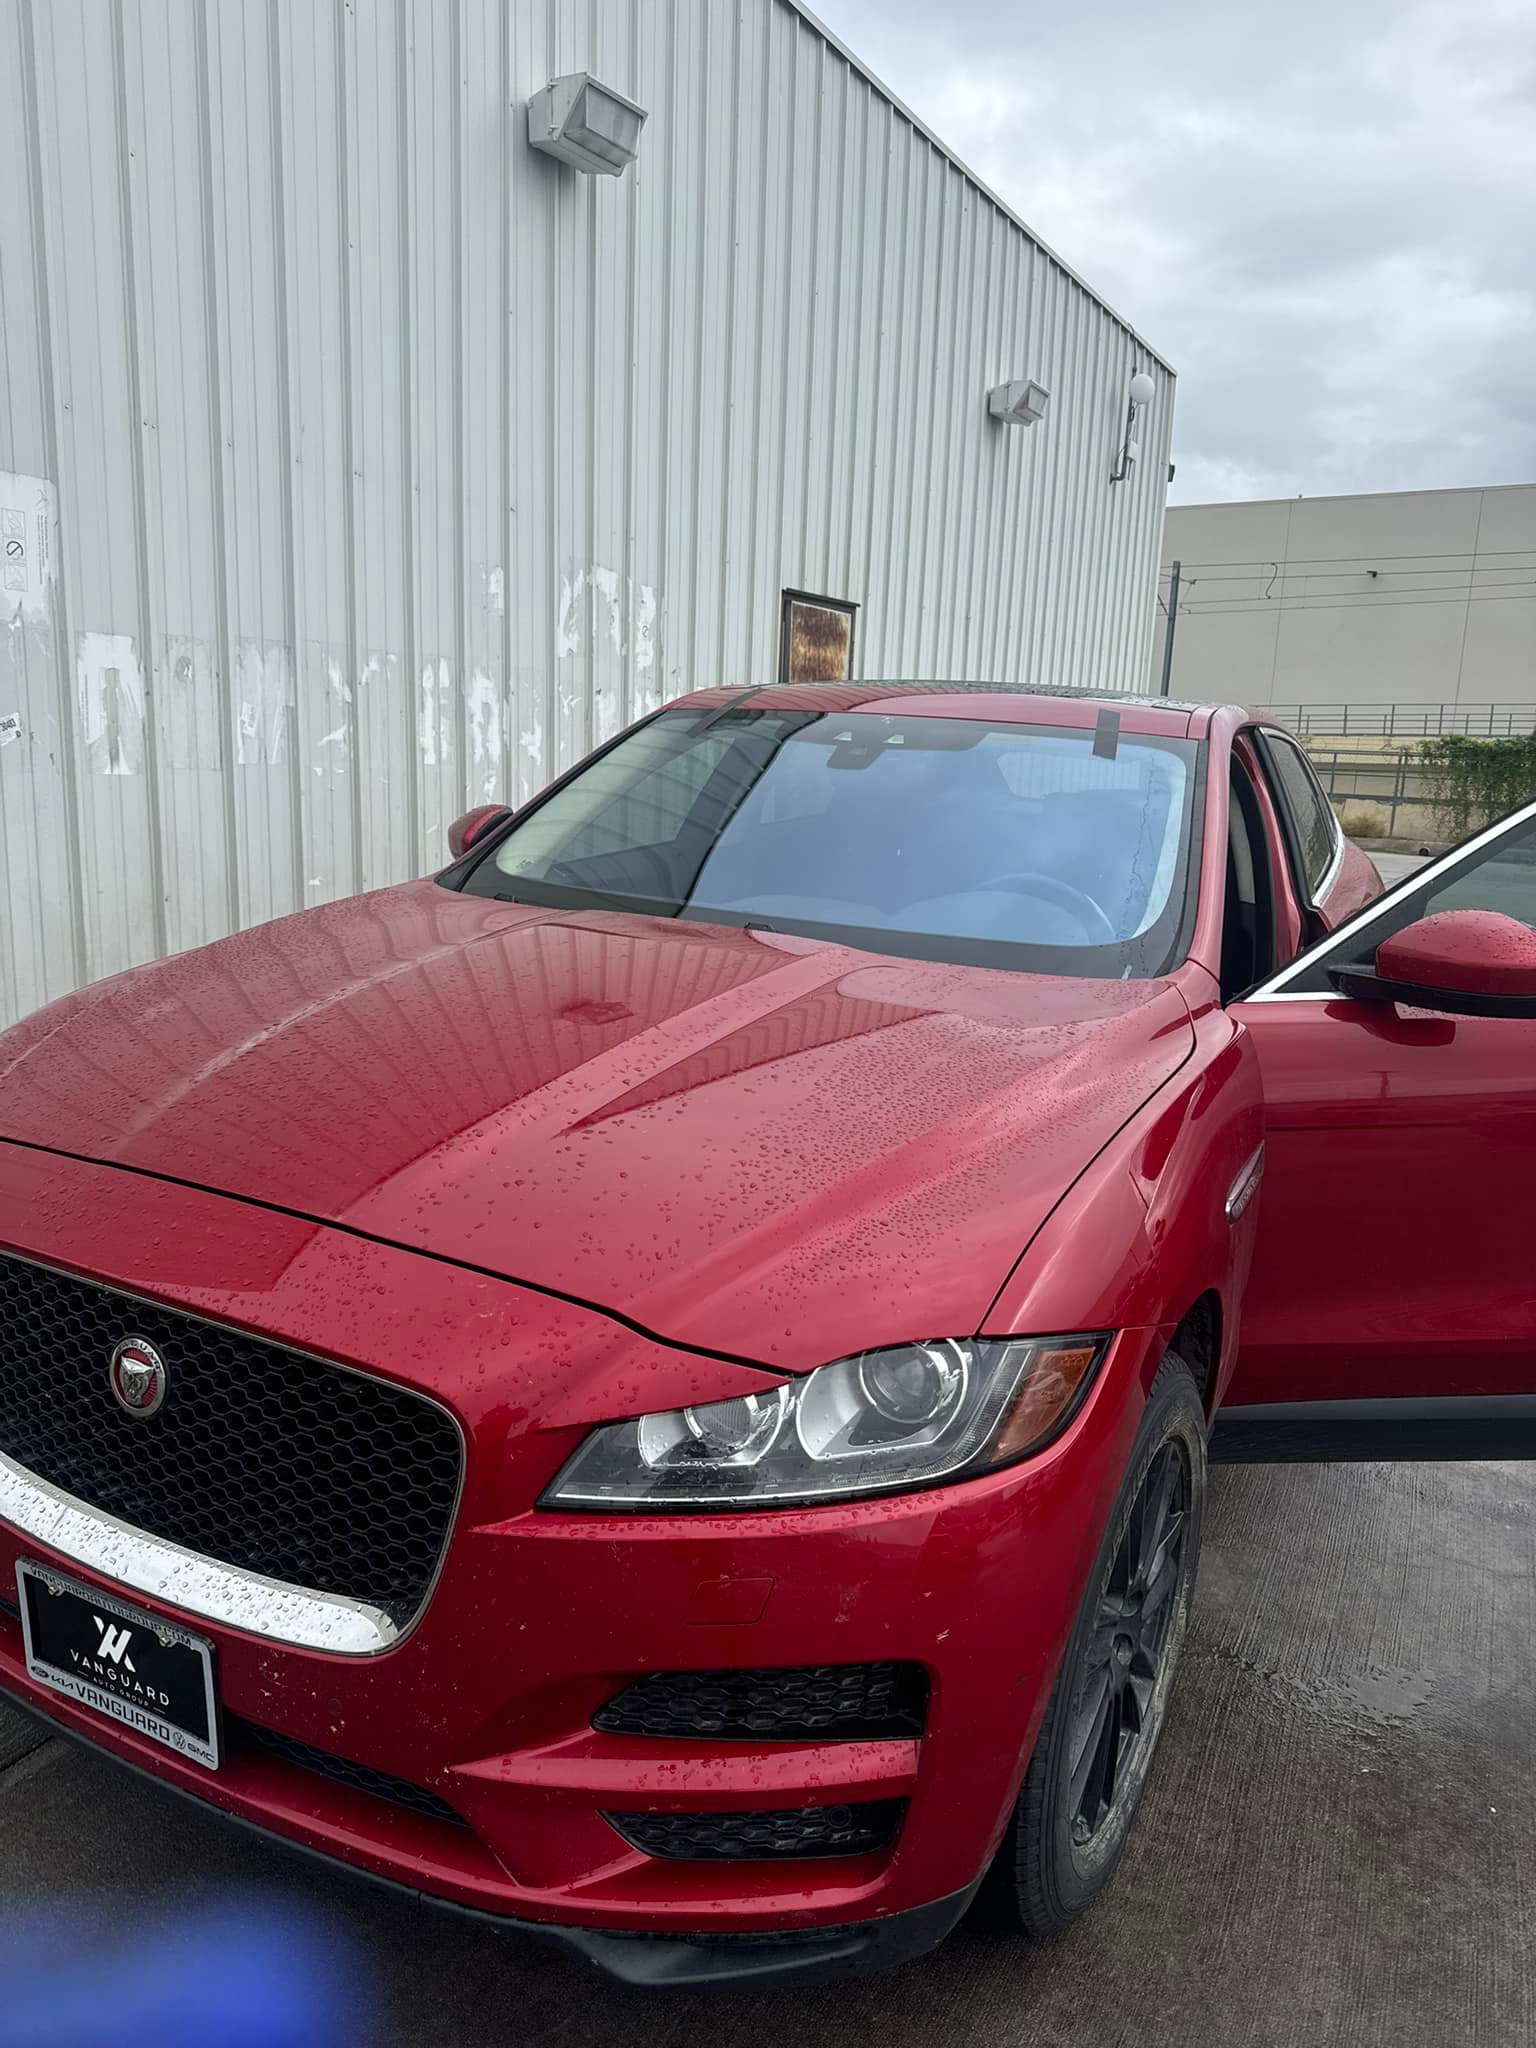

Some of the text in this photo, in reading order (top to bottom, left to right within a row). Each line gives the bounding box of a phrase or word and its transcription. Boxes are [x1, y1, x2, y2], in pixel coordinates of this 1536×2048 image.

[70, 1648, 170, 1706] VANGUARD
[75, 1682, 170, 1742] VANGUARD
[187, 1742, 216, 1764] GMC
